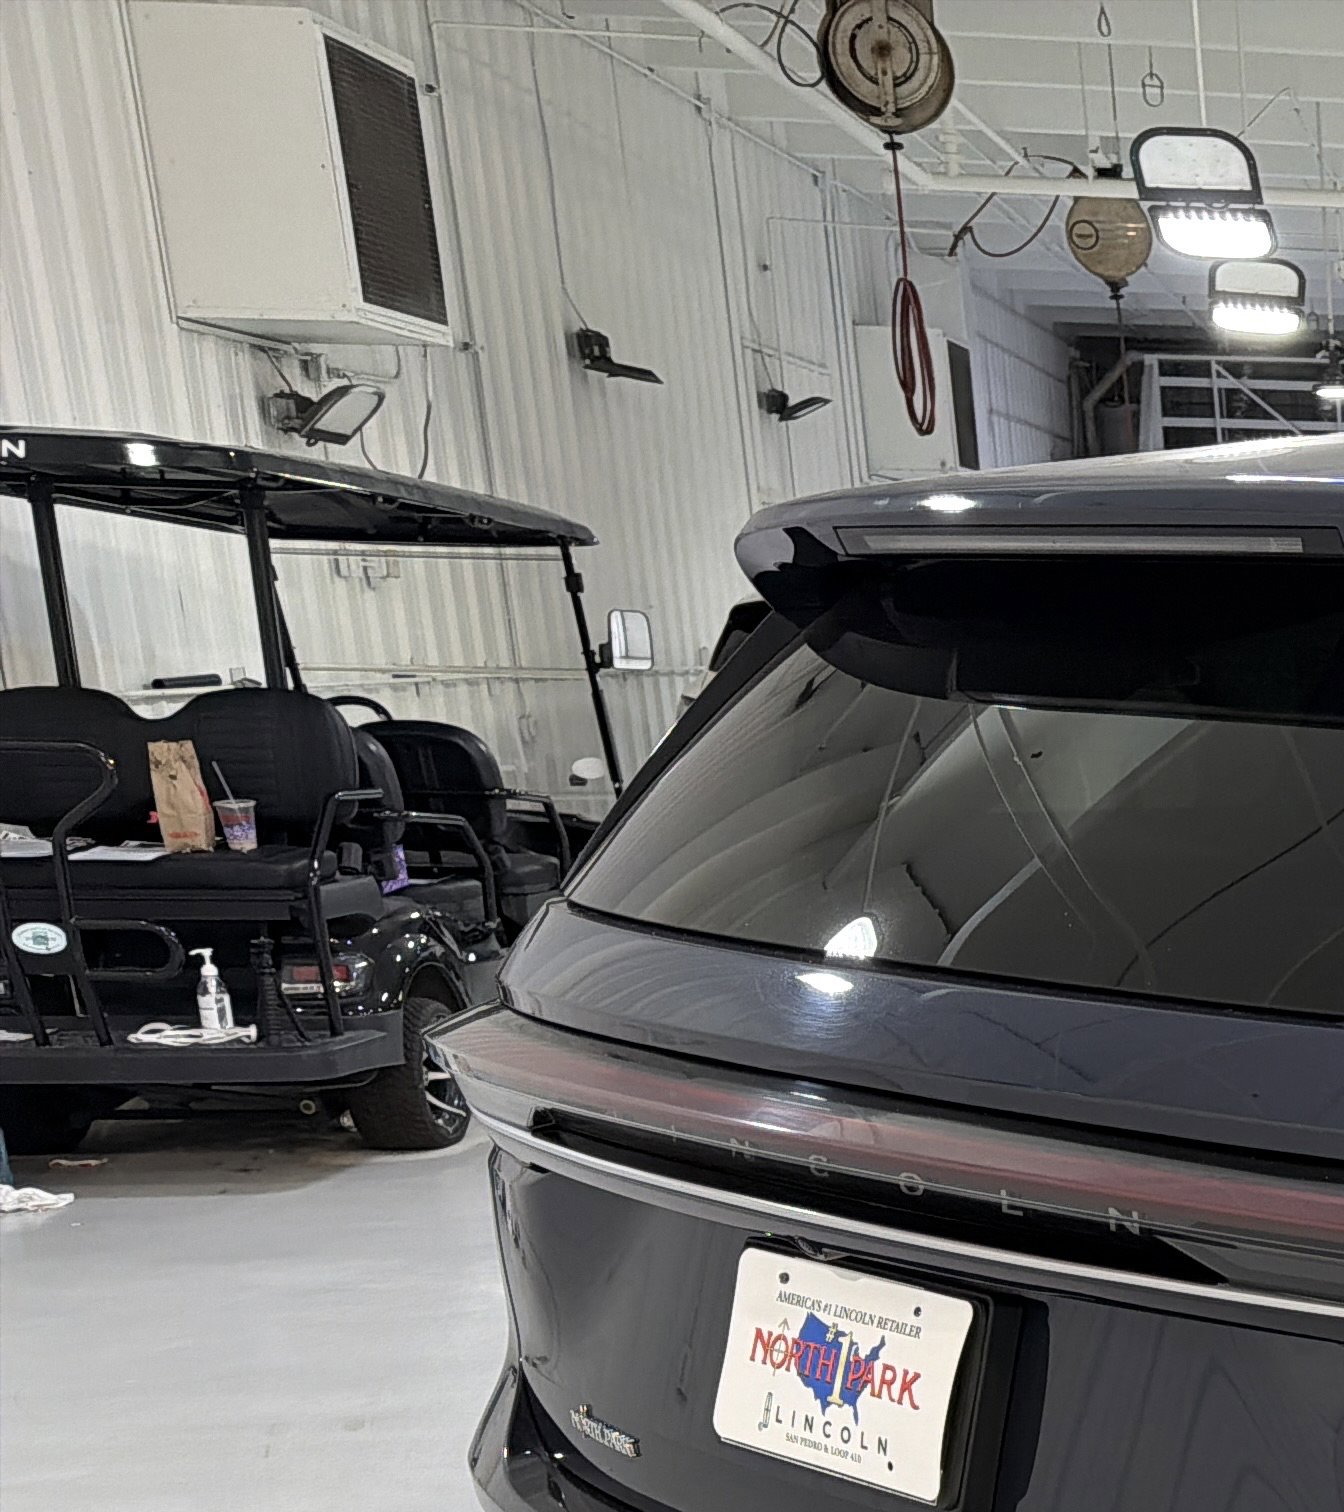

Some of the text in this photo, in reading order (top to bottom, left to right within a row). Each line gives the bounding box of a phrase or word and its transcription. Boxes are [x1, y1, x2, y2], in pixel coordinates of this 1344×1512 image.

[608, 1110, 1141, 1236] INCOLN
[776, 1289, 922, 1339] AMERICA'S #1 LINCOLN RETAILER
[749, 1327, 921, 1411] NORTH PARK
[775, 1405, 888, 1457] LINCOLN
[785, 1432, 799, 1444] SAN
[799, 1436, 823, 1452] PEDRO
[831, 1445, 849, 1460] LOOP
